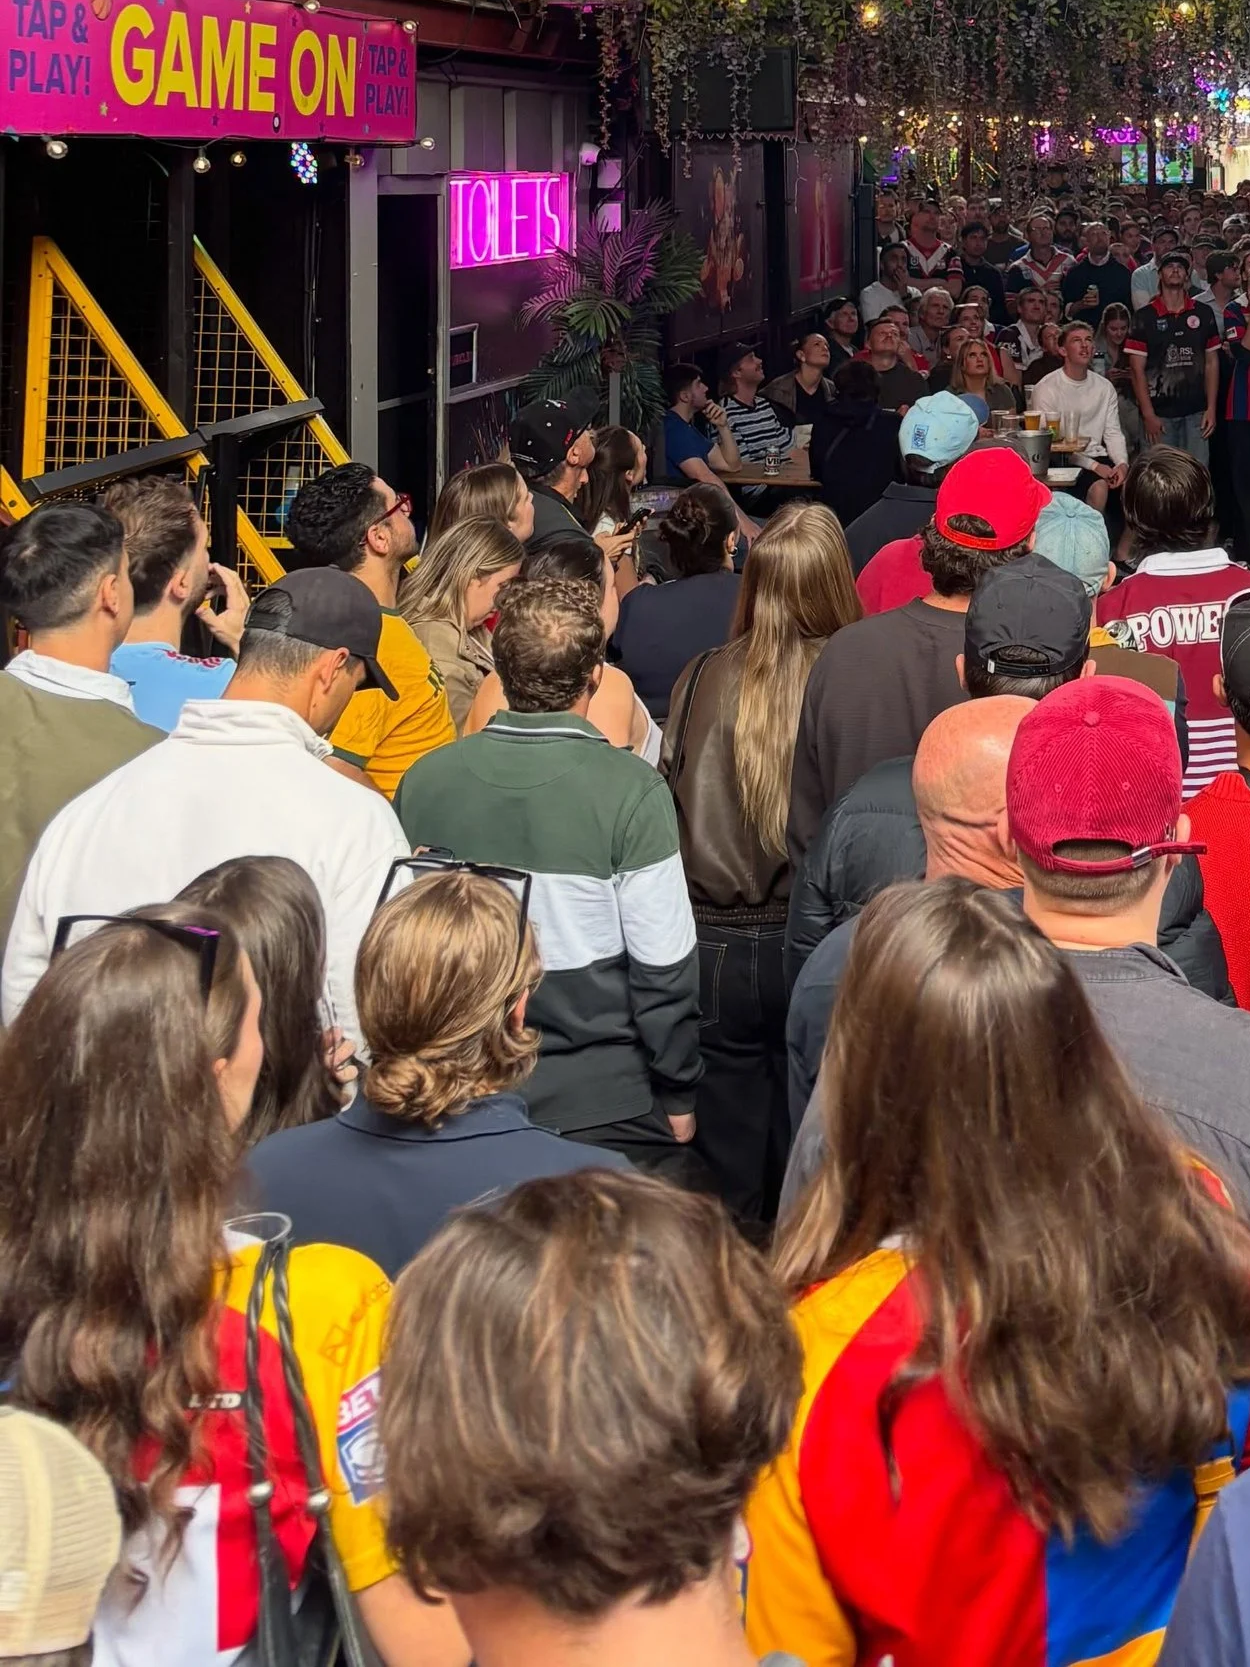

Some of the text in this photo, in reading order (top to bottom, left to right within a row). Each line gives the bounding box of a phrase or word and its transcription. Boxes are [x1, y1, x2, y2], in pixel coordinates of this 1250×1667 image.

[72, 6, 89, 45] &
[8, 48, 91, 95] PLAY!
[110, 3, 357, 117] GAME ON
[368, 44, 409, 77] TAP &
[364, 83, 409, 117] PLAY!
[449, 178, 560, 263] TOILETS
